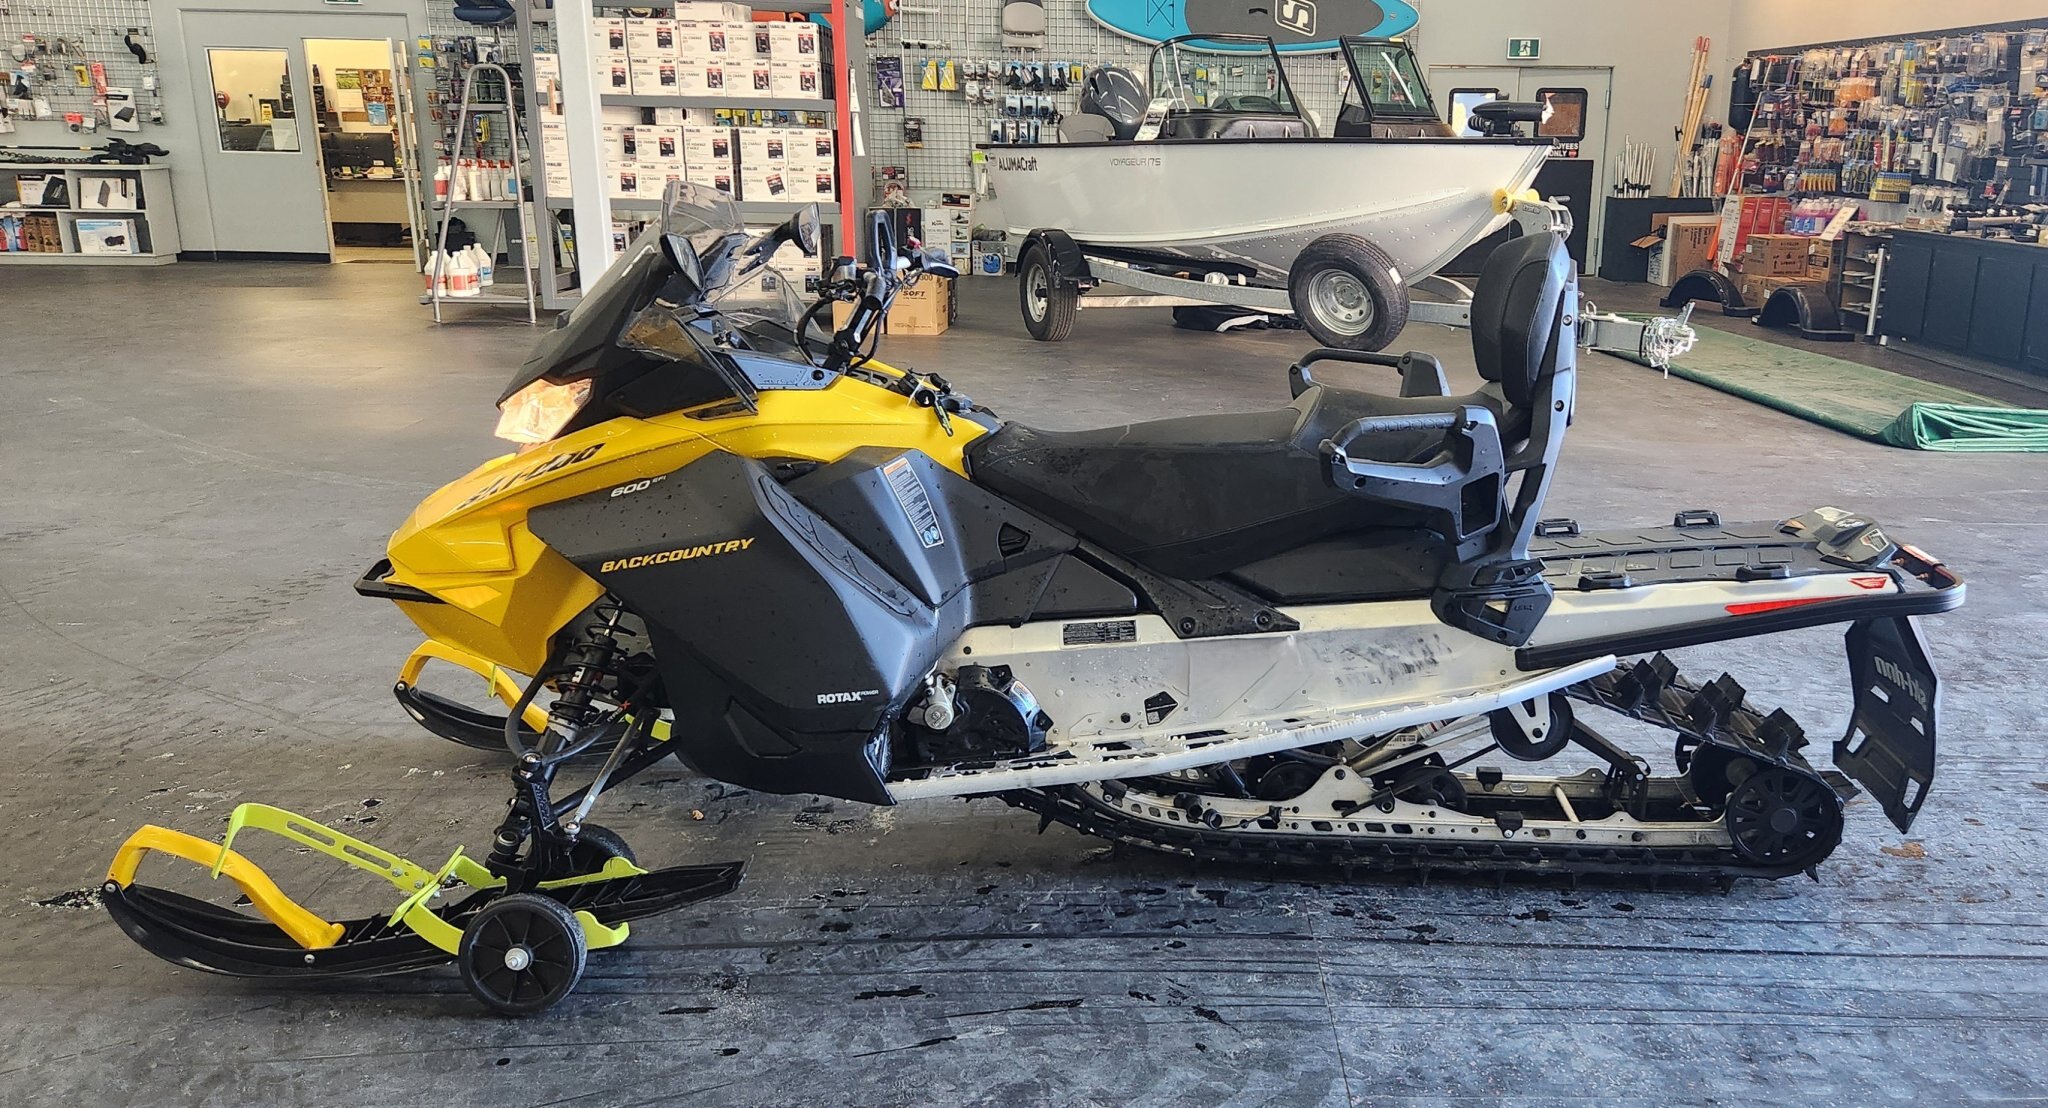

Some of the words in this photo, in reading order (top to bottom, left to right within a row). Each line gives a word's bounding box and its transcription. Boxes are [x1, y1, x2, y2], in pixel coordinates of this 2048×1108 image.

[998, 156, 1038, 171] ALUMACraft
[610, 480, 651, 497] 600
[600, 538, 755, 573] BACKCOUNTRY
[817, 691, 861, 704] ROTAX
